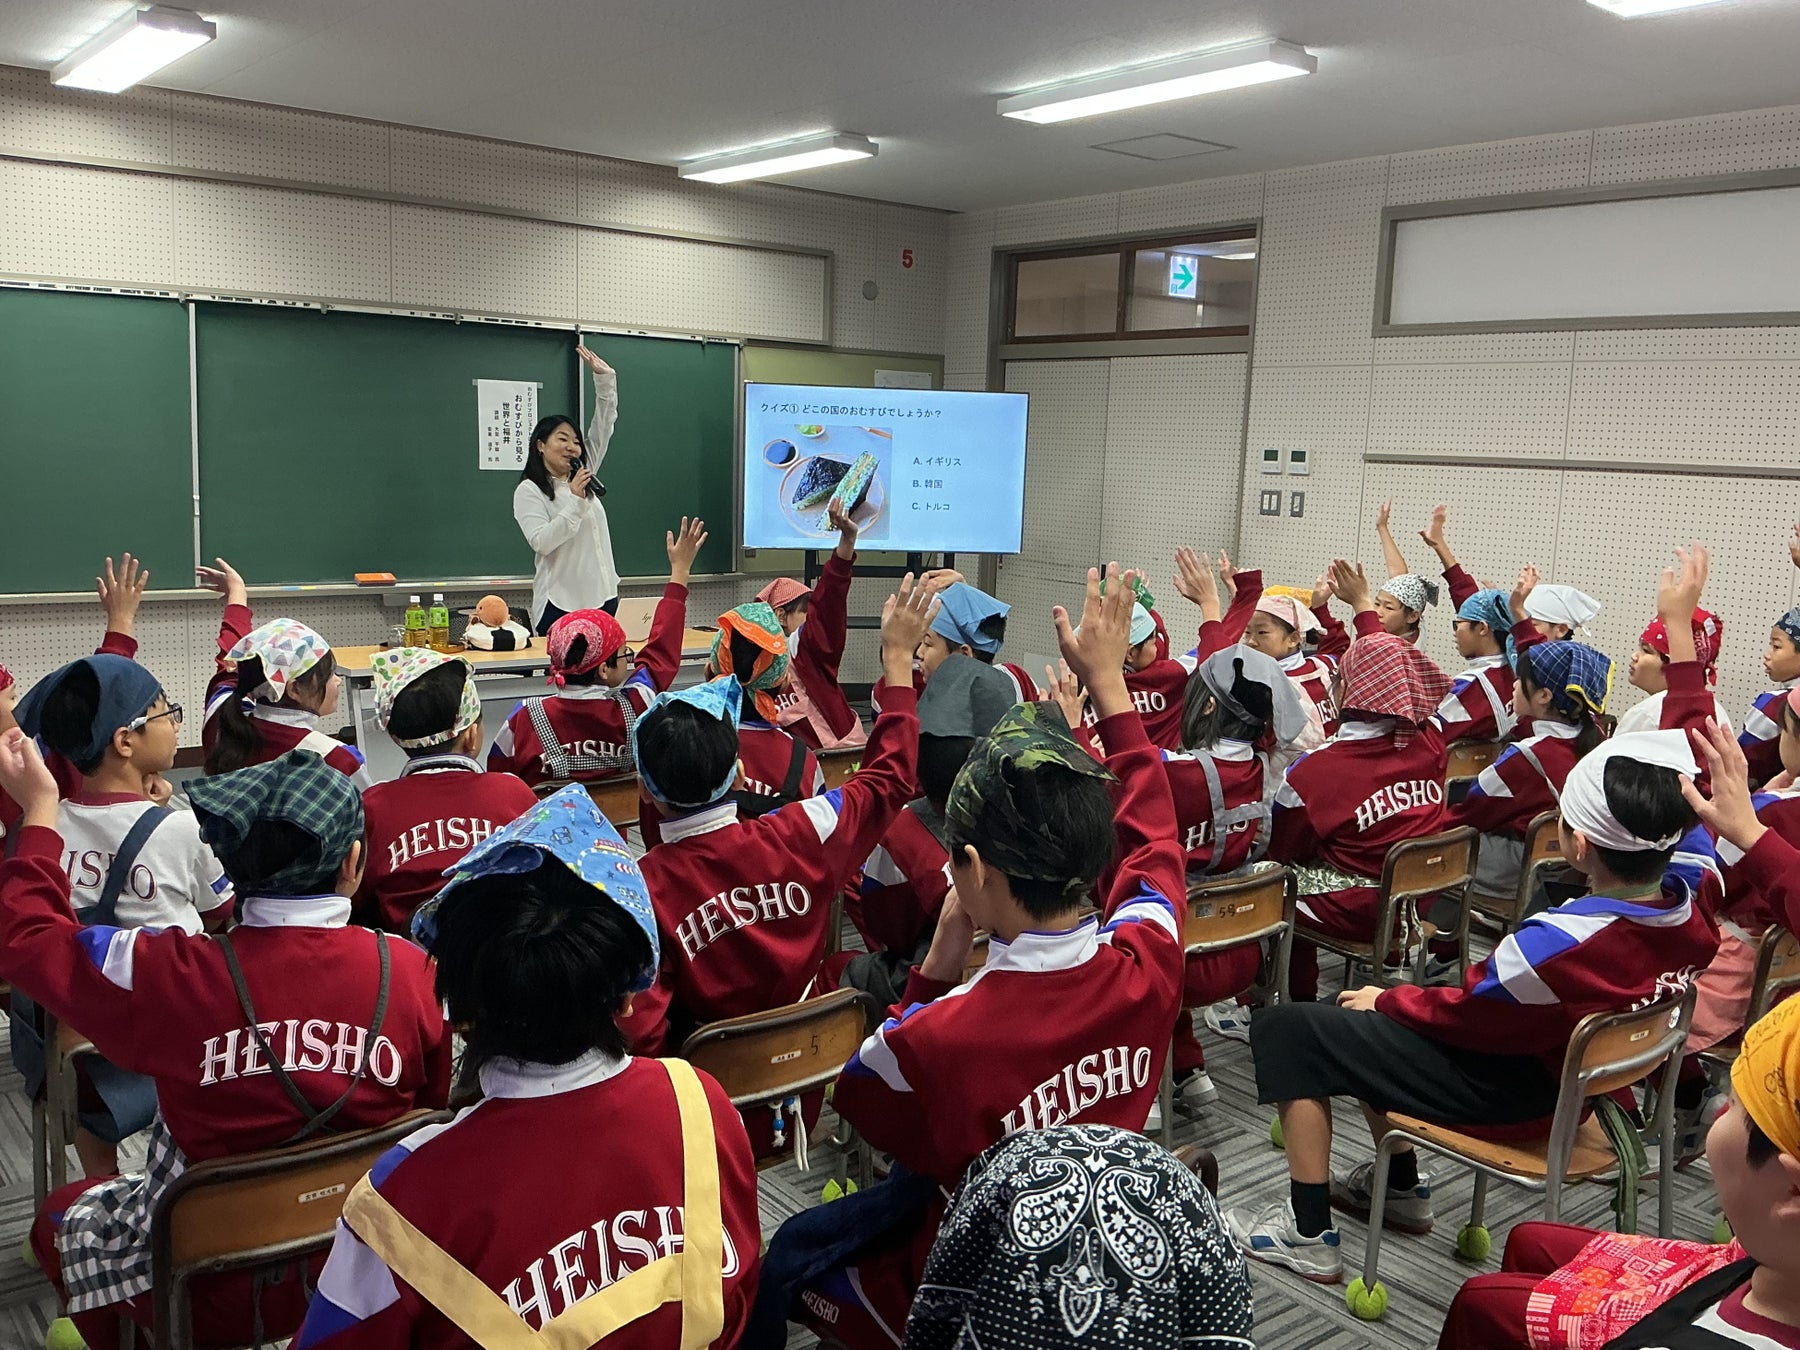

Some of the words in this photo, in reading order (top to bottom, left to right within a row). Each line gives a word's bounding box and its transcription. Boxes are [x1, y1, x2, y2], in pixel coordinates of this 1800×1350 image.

[902, 249, 914, 269] 5
[502, 402, 511, 444] 世界と福井
[760, 403, 799, 413] クイズ①
[514, 394, 523, 463] おむすびから見る
[913, 457, 922, 465] A.
[926, 457, 961, 466] イギリス
[925, 479, 943, 488] 韓国
[912, 502, 921, 510] C.
[926, 502, 950, 510] トルコ
[1354, 780, 1443, 833] HEISHO
[387, 817, 505, 873] HEISH
[676, 882, 812, 961] HEISHO
[199, 1019, 402, 1087] HEISHO
[811, 1035, 818, 1055] 5
[1000, 1046, 1151, 1137] HEISHO
[802, 1290, 840, 1323] HEISHO
